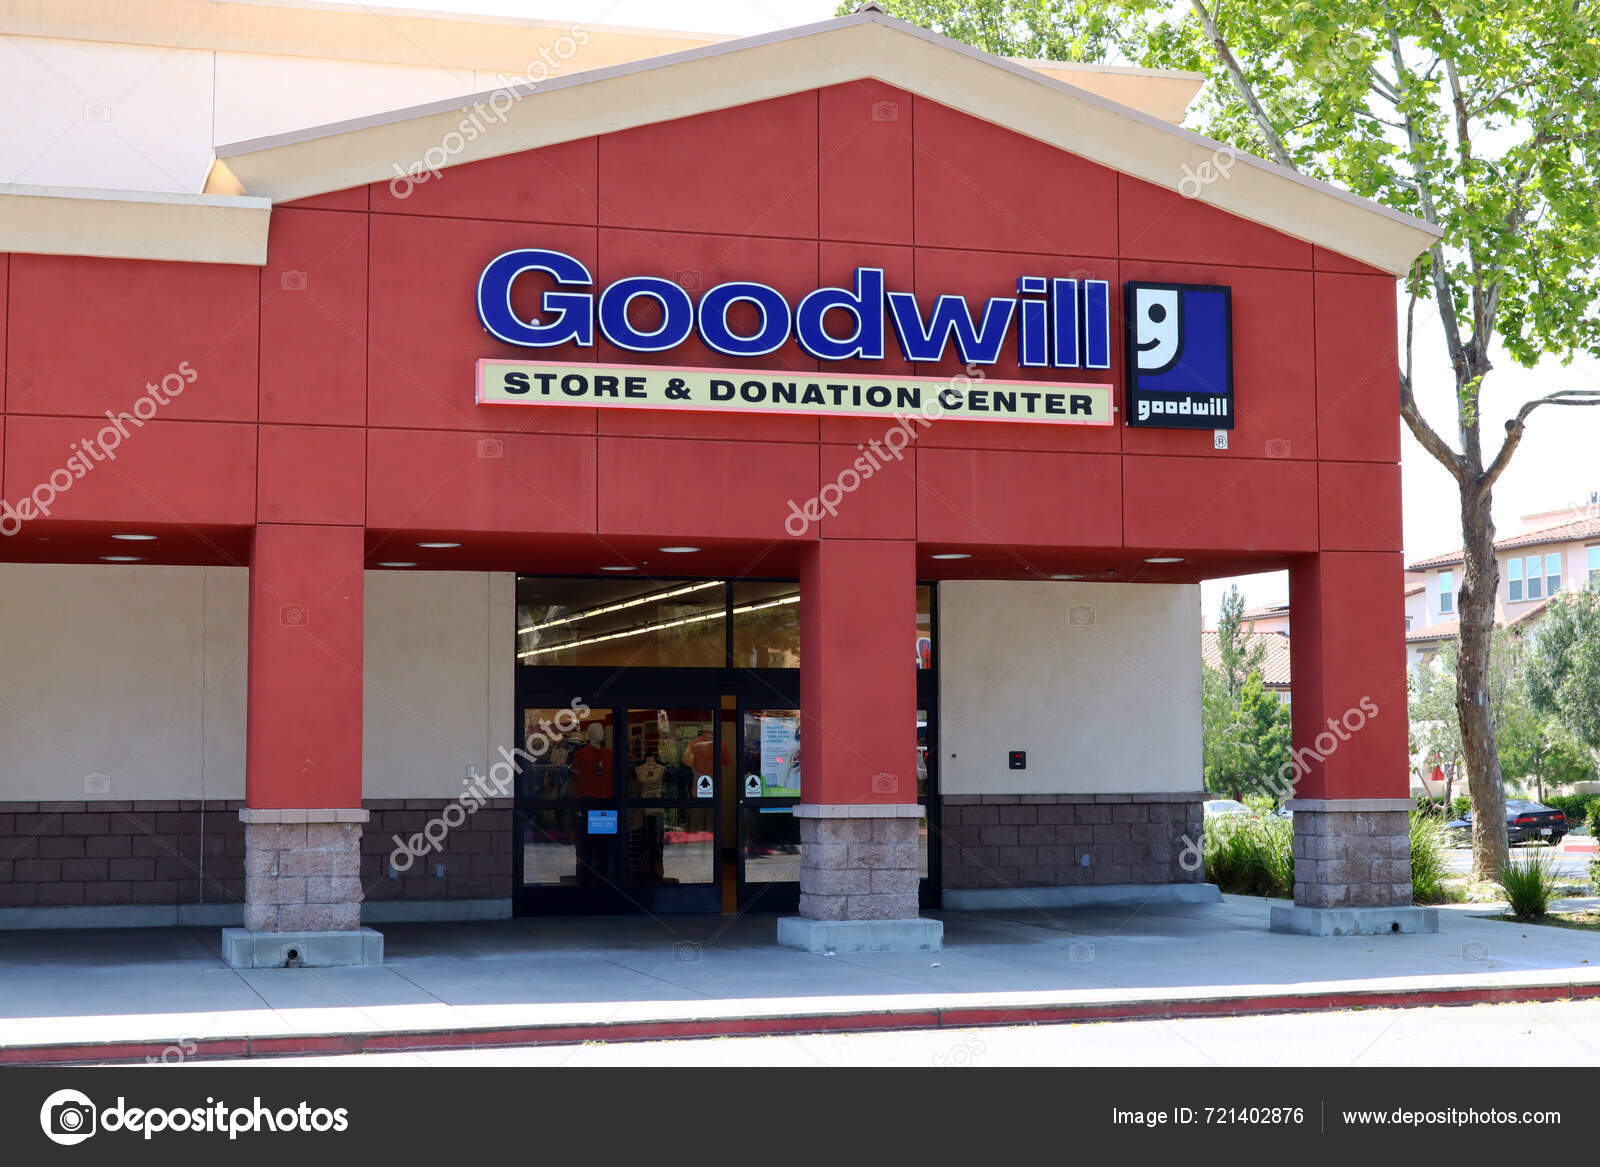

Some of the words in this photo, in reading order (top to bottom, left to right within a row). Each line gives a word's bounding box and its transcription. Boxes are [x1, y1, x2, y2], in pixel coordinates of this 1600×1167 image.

[475, 248, 1111, 370] Goodwill
[504, 372, 649, 399] STORE
[664, 378, 692, 400] &
[709, 379, 921, 410] DONATION
[938, 390, 1093, 415] CENTER
[1137, 396, 1228, 421] goodwill
